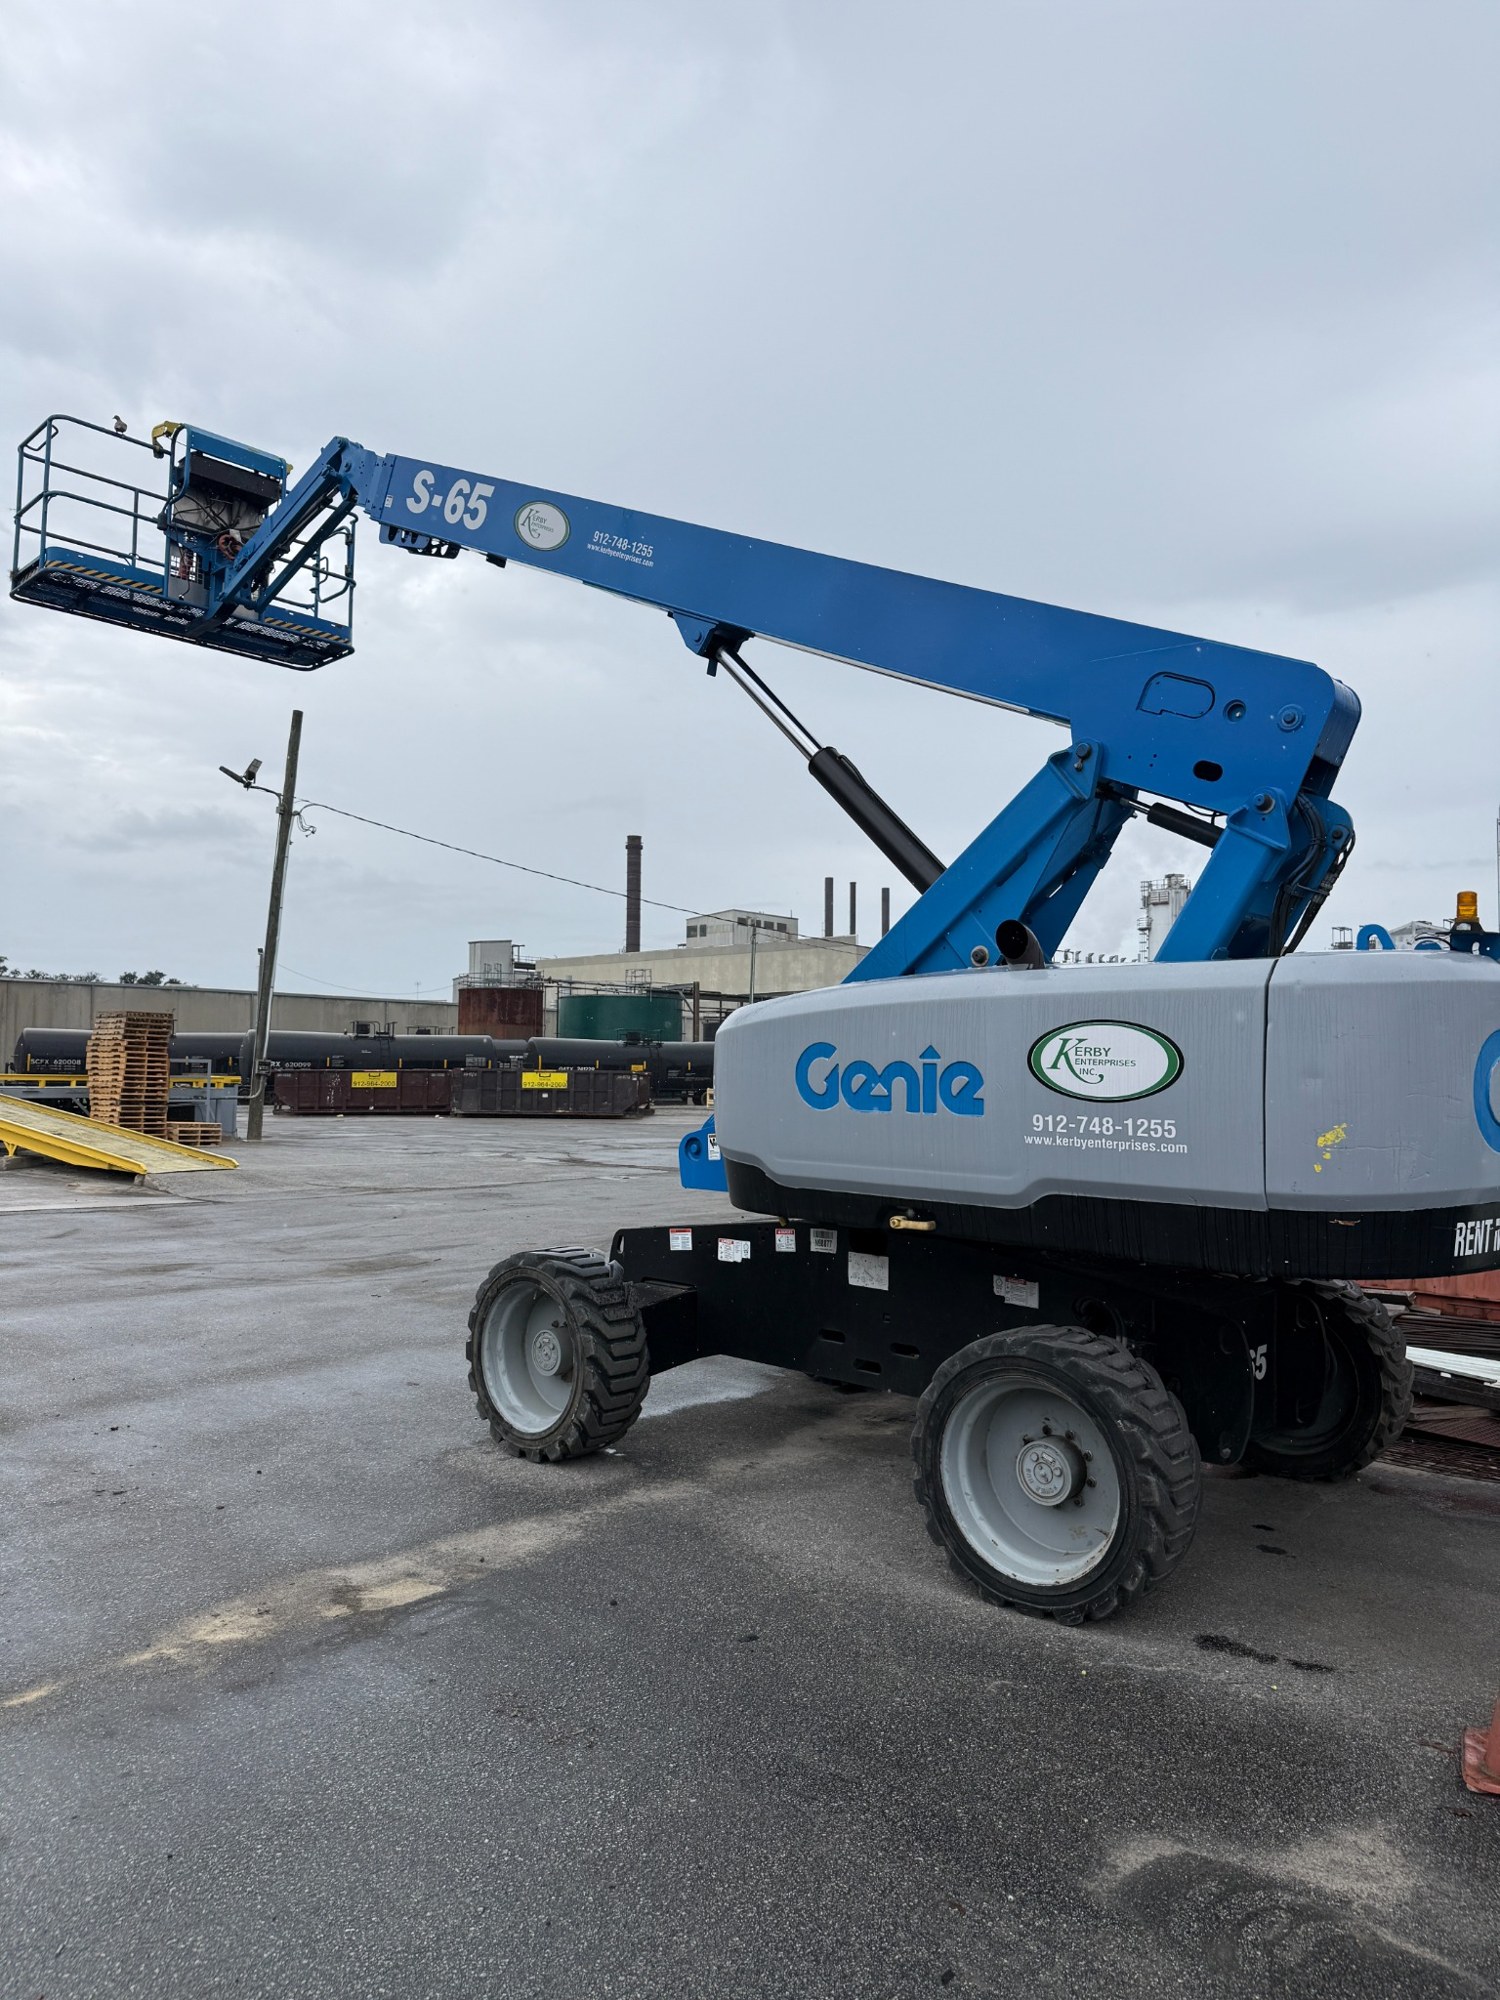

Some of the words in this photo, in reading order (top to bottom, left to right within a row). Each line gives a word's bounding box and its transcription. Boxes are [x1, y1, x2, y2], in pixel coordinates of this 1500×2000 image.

[406, 469, 495, 530] S-65
[587, 543, 654, 567] www.kerbyenterprises.com
[593, 530, 654, 558] 912-748-1255
[1074, 1057, 1137, 1067] ENTERPRISES
[1078, 1067, 1098, 1076] INC.
[795, 1041, 985, 1117] Genie
[1032, 1114, 1177, 1138] 912-748-1255
[1023, 1134, 1188, 1154] www.kerbyenterprises.com
[1454, 1219, 1494, 1257] RENT
